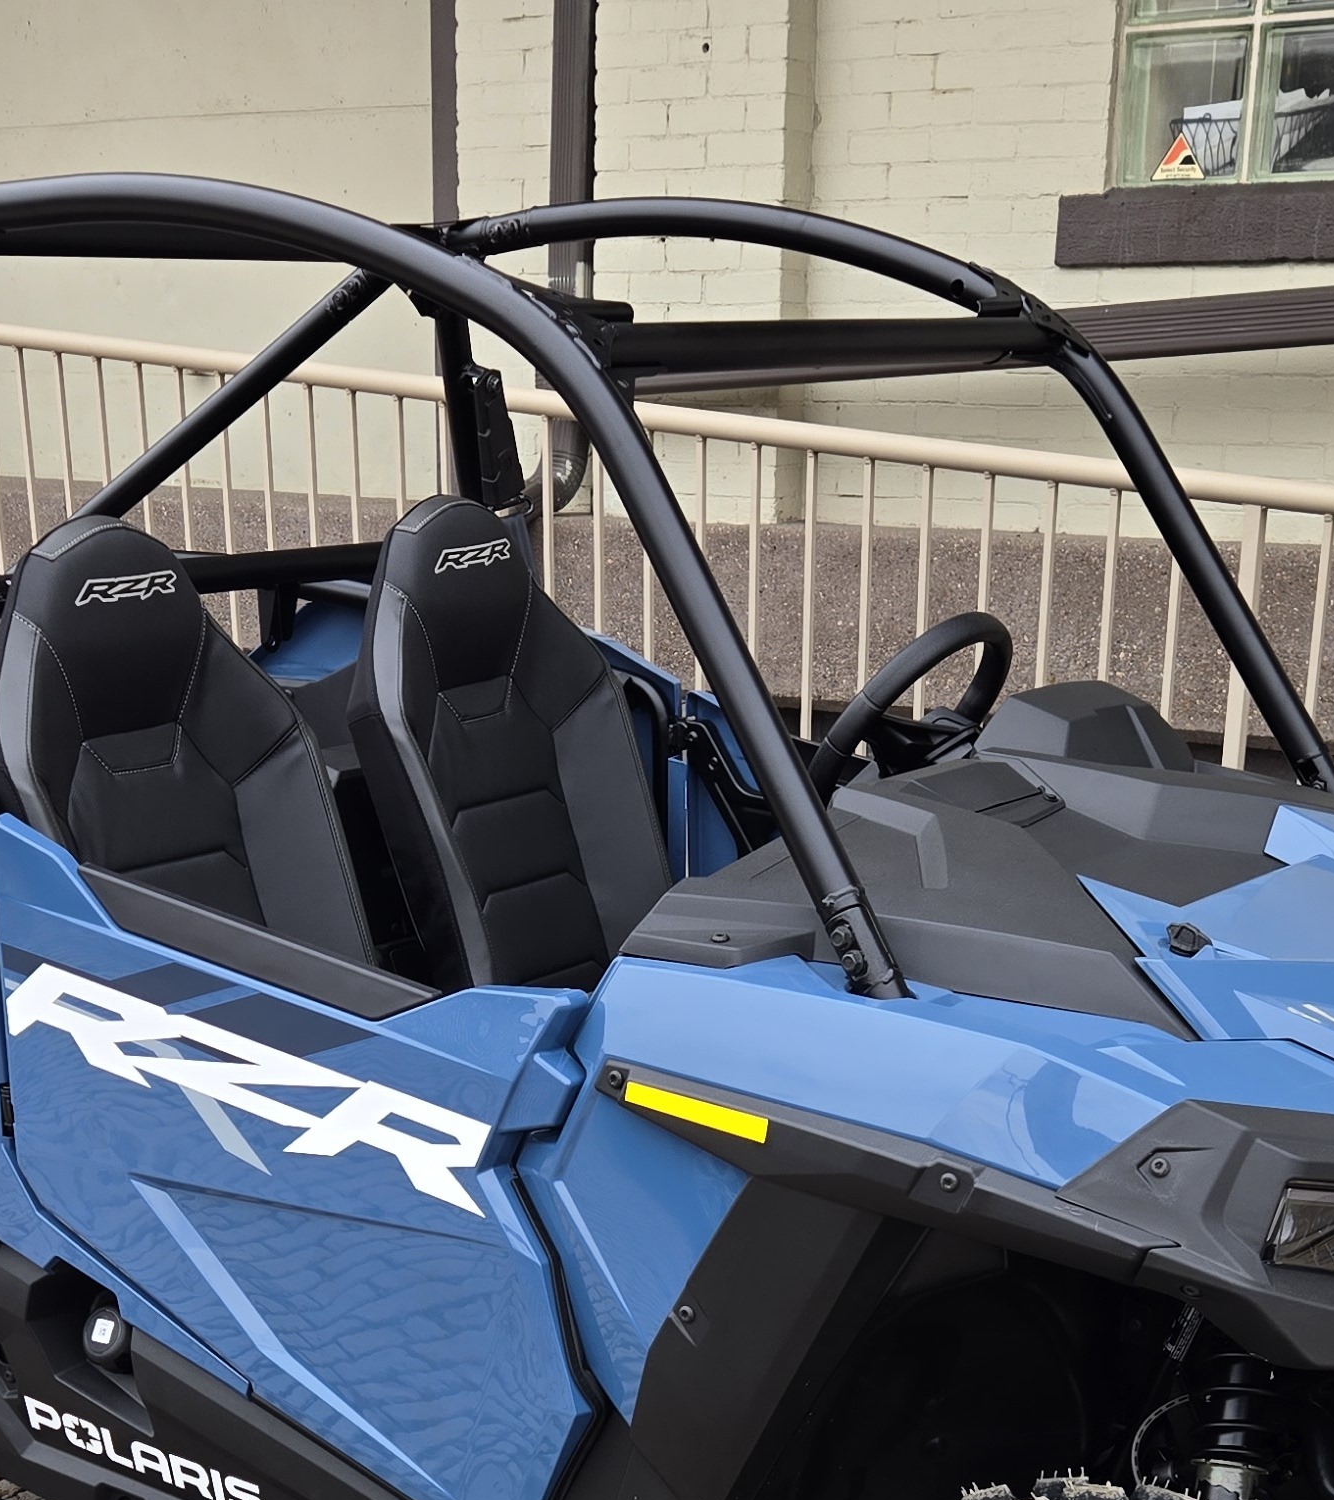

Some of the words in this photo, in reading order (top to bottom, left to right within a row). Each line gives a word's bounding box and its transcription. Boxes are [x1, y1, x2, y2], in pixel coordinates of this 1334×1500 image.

[434, 538, 511, 574] RZR
[75, 570, 177, 606] RZR
[5, 963, 492, 1219] RZR
